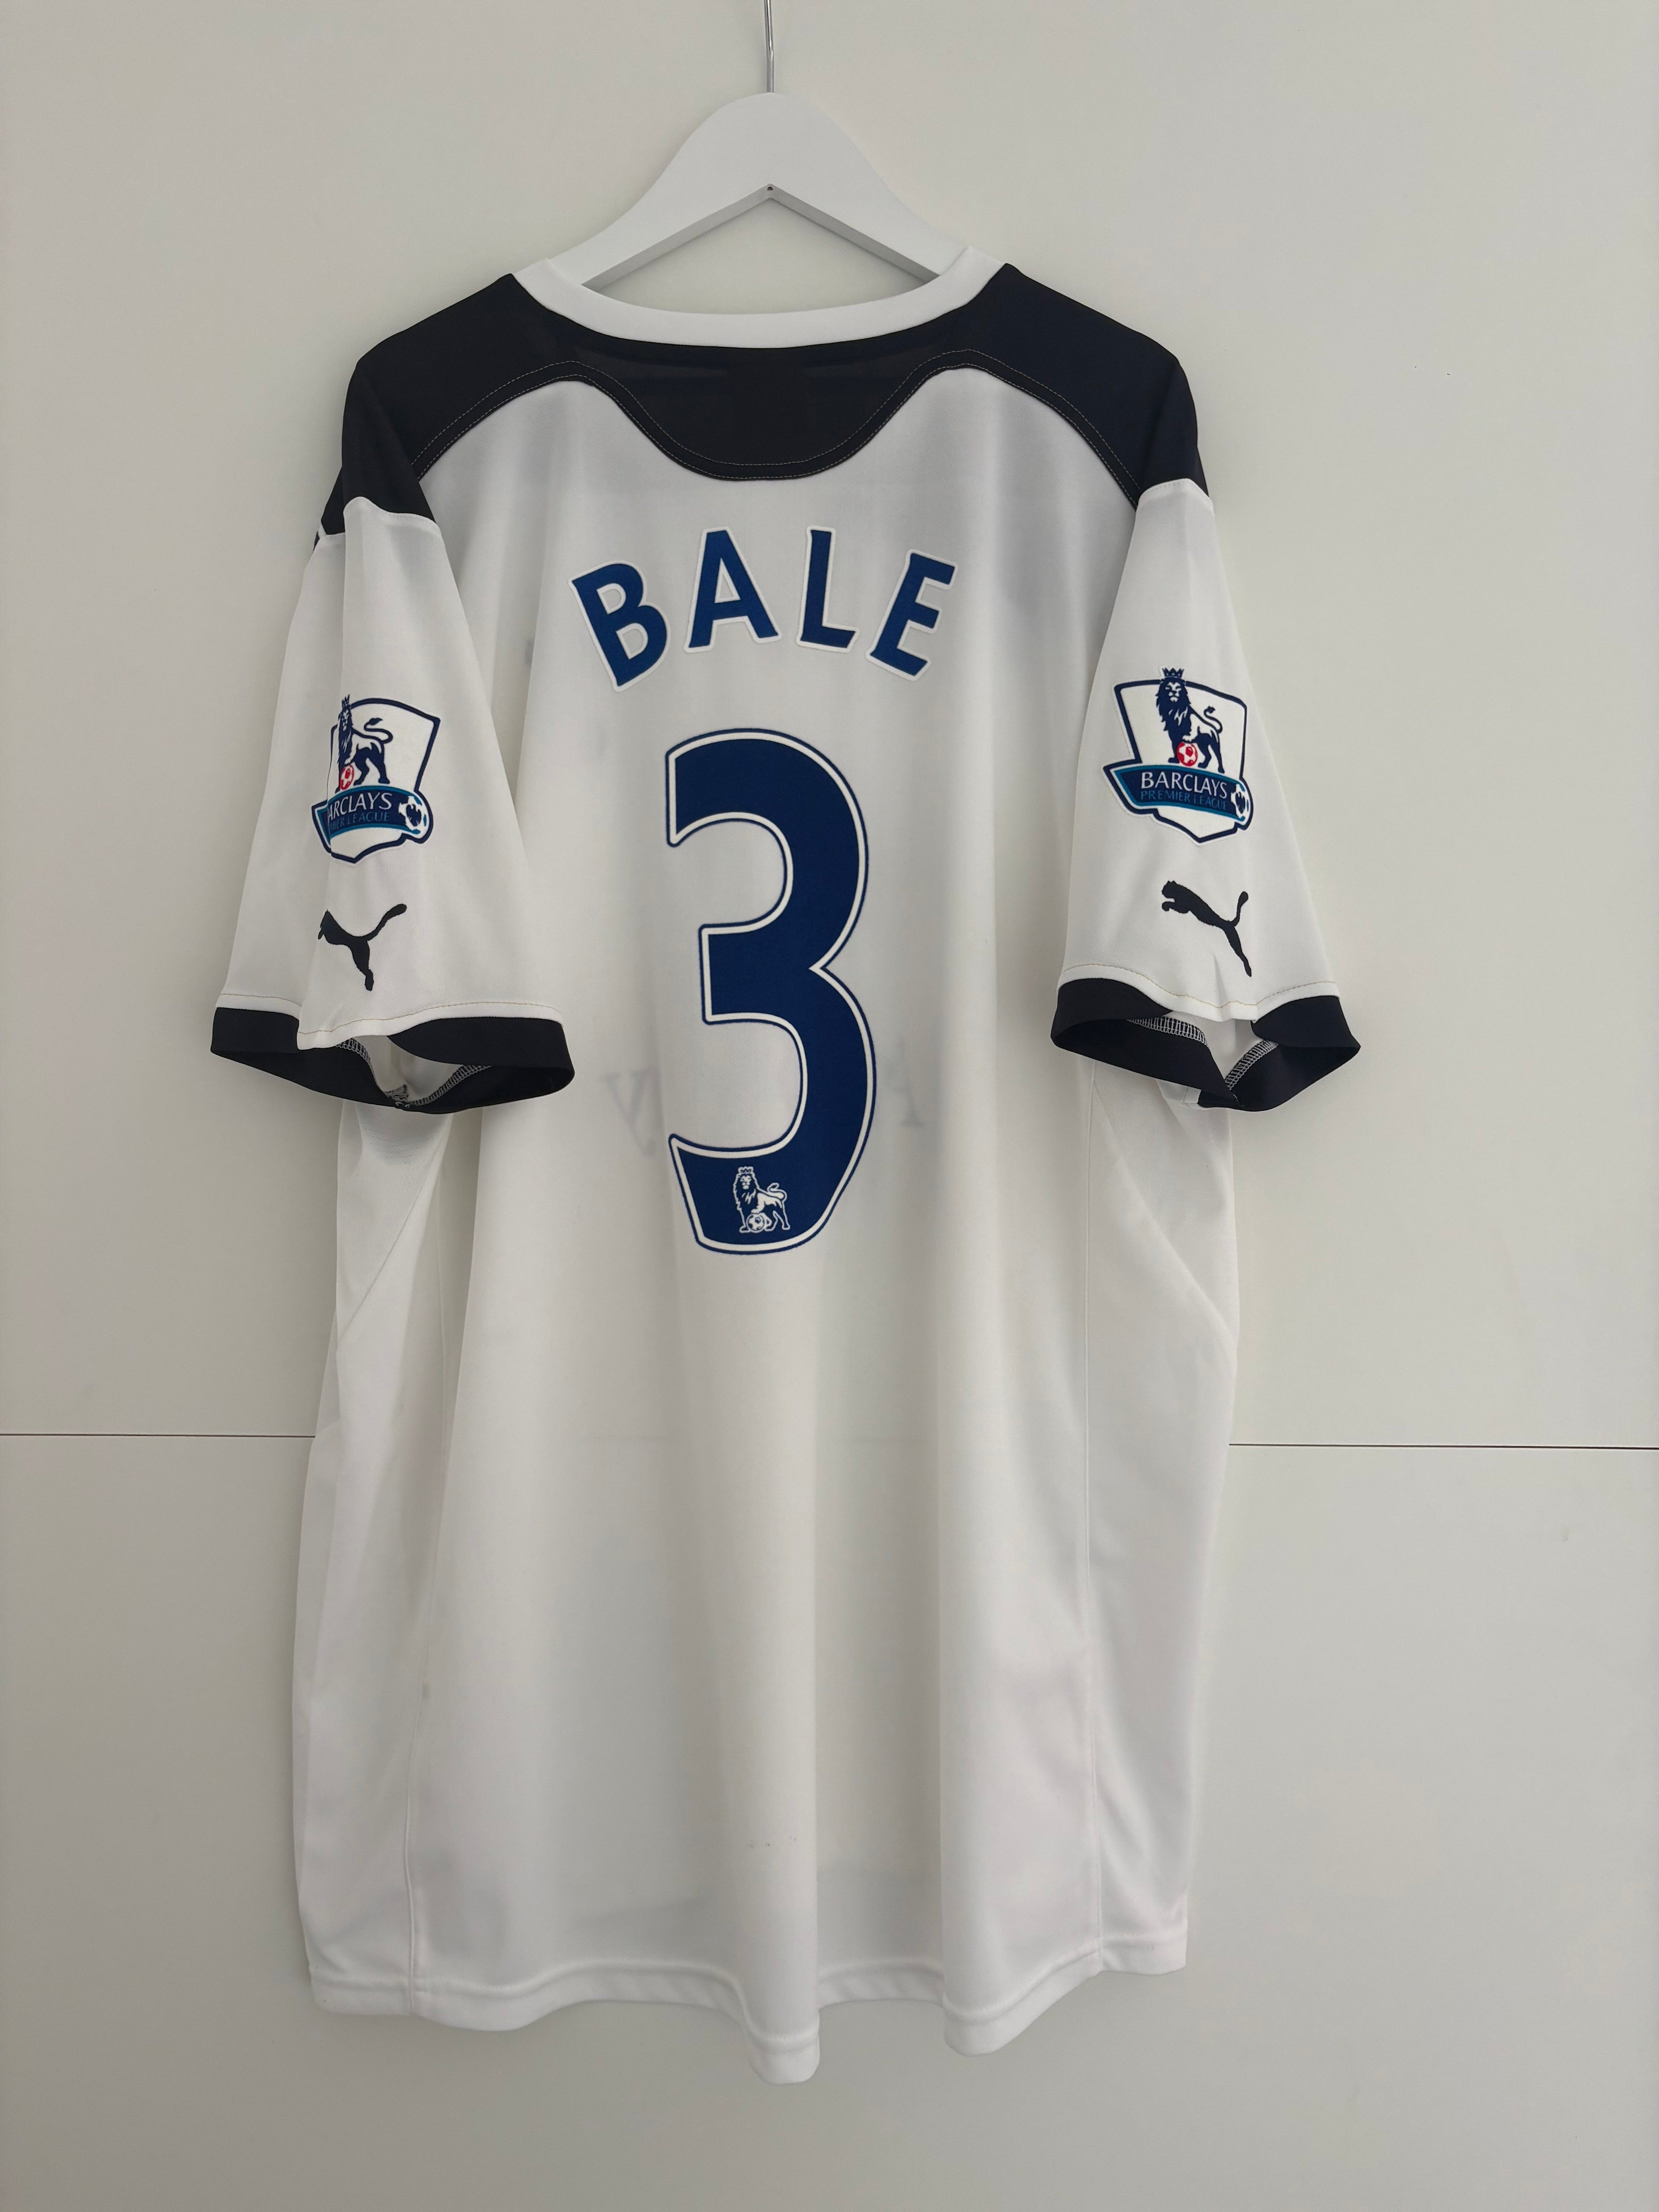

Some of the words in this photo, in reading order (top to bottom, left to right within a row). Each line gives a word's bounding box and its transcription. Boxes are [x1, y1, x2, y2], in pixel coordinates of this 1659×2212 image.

[570, 527, 957, 690] BALE
[1141, 772, 1227, 799] BARCLAYS
[327, 792, 392, 820] ARCLAYS
[1141, 790, 1190, 803] PREMIER
[1194, 795, 1227, 810] LEAGUE
[347, 812, 391, 825] LEAGUE
[666, 728, 876, 1255] 3
